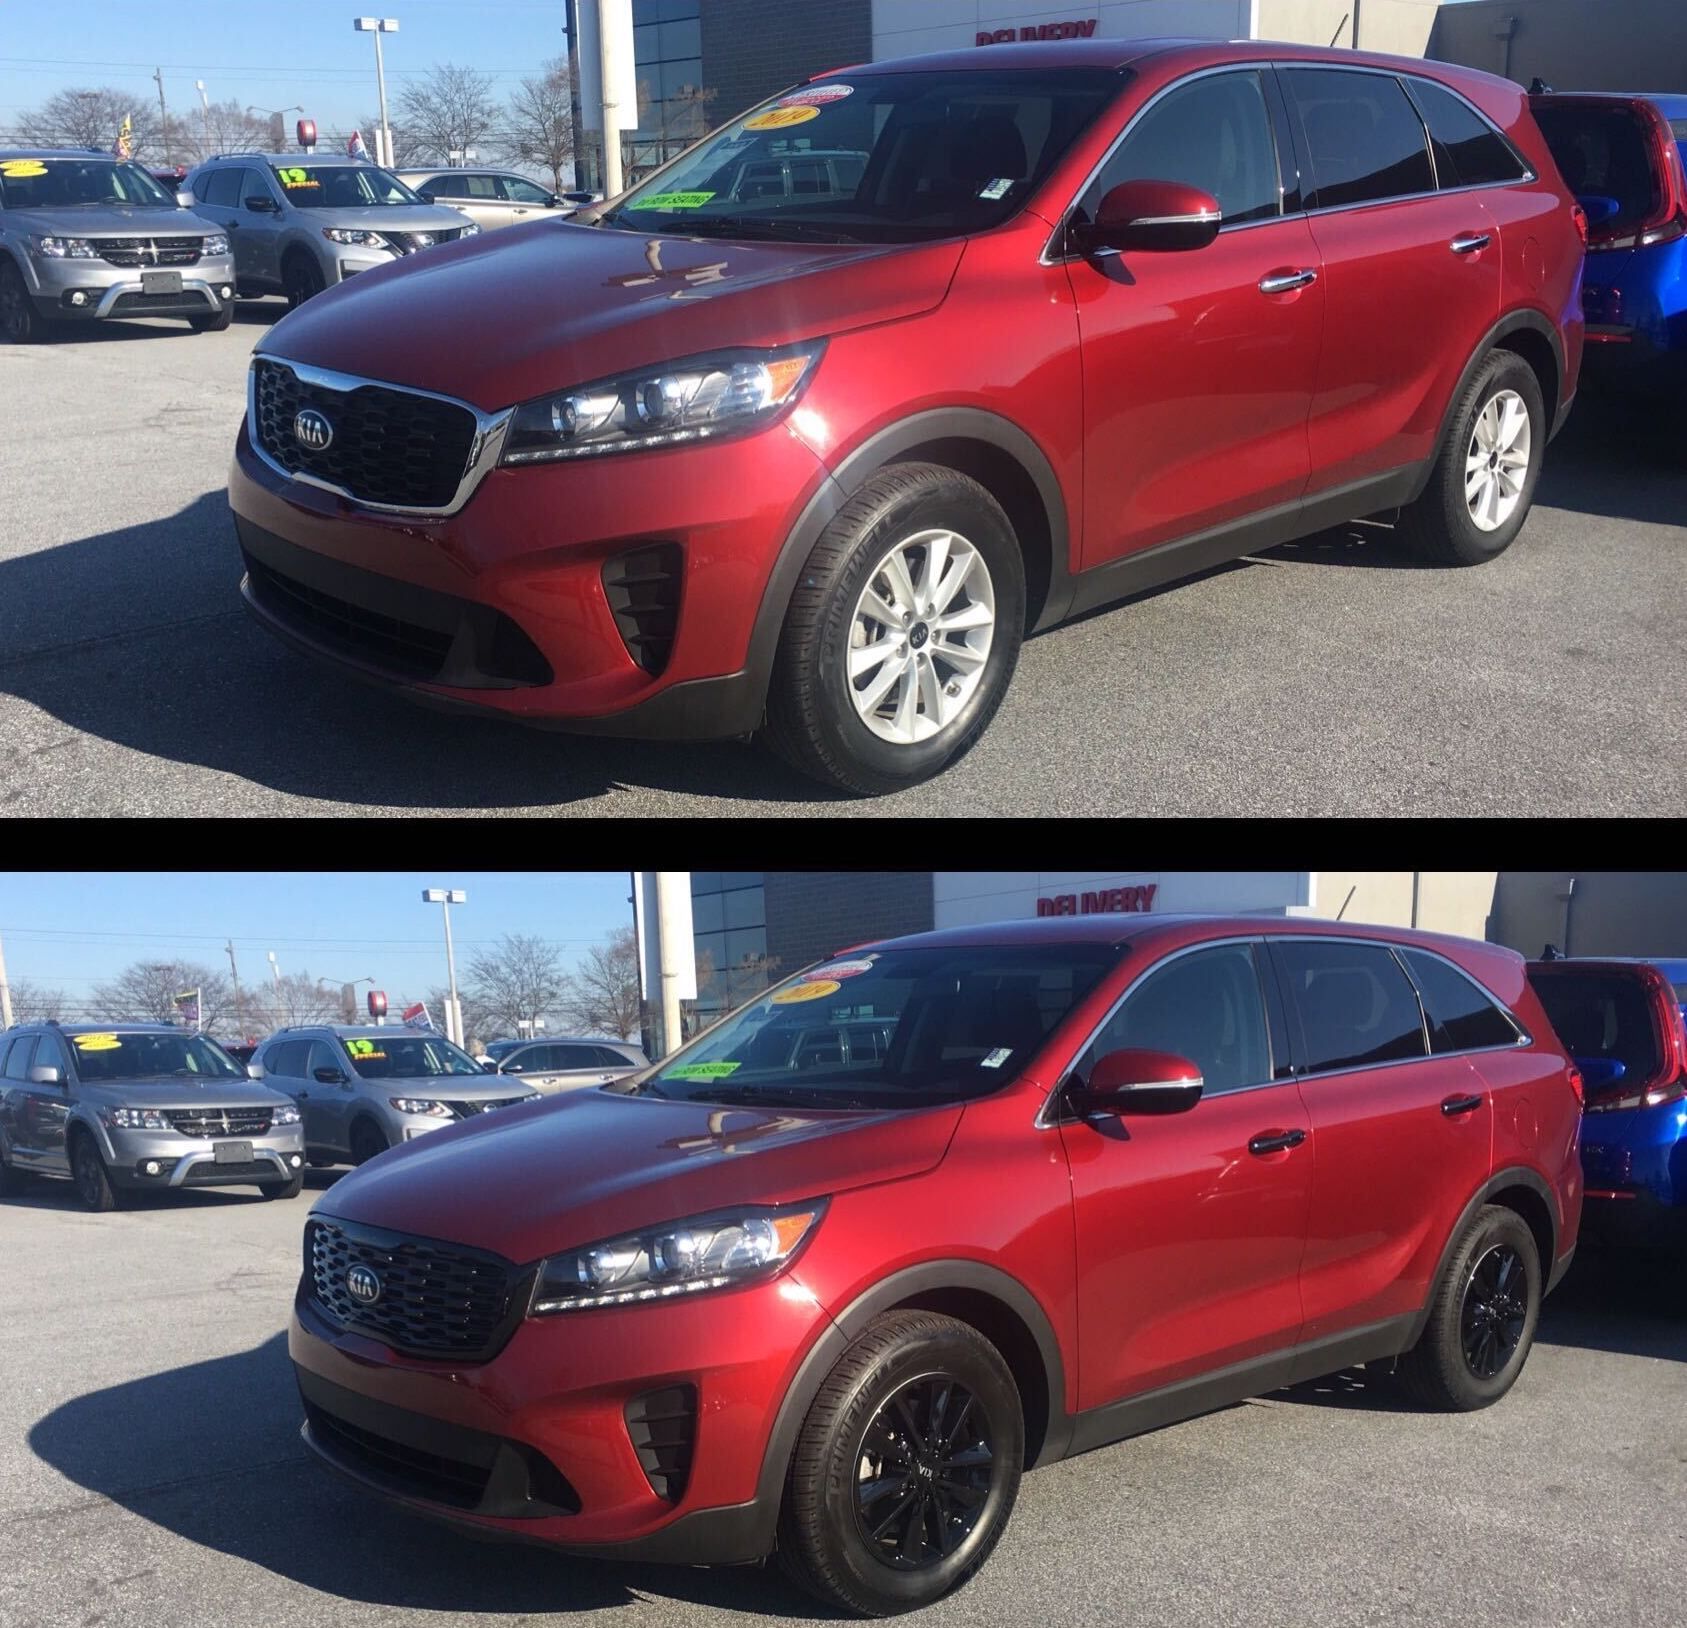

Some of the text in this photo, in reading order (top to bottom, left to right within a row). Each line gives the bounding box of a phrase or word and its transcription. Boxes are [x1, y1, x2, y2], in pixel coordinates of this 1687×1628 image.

[279, 168, 307, 183] 19
[297, 416, 324, 444] KIA
[1037, 883, 1157, 917] DELIVERY
[346, 1040, 374, 1055] 19
[349, 1271, 374, 1297] KIA
